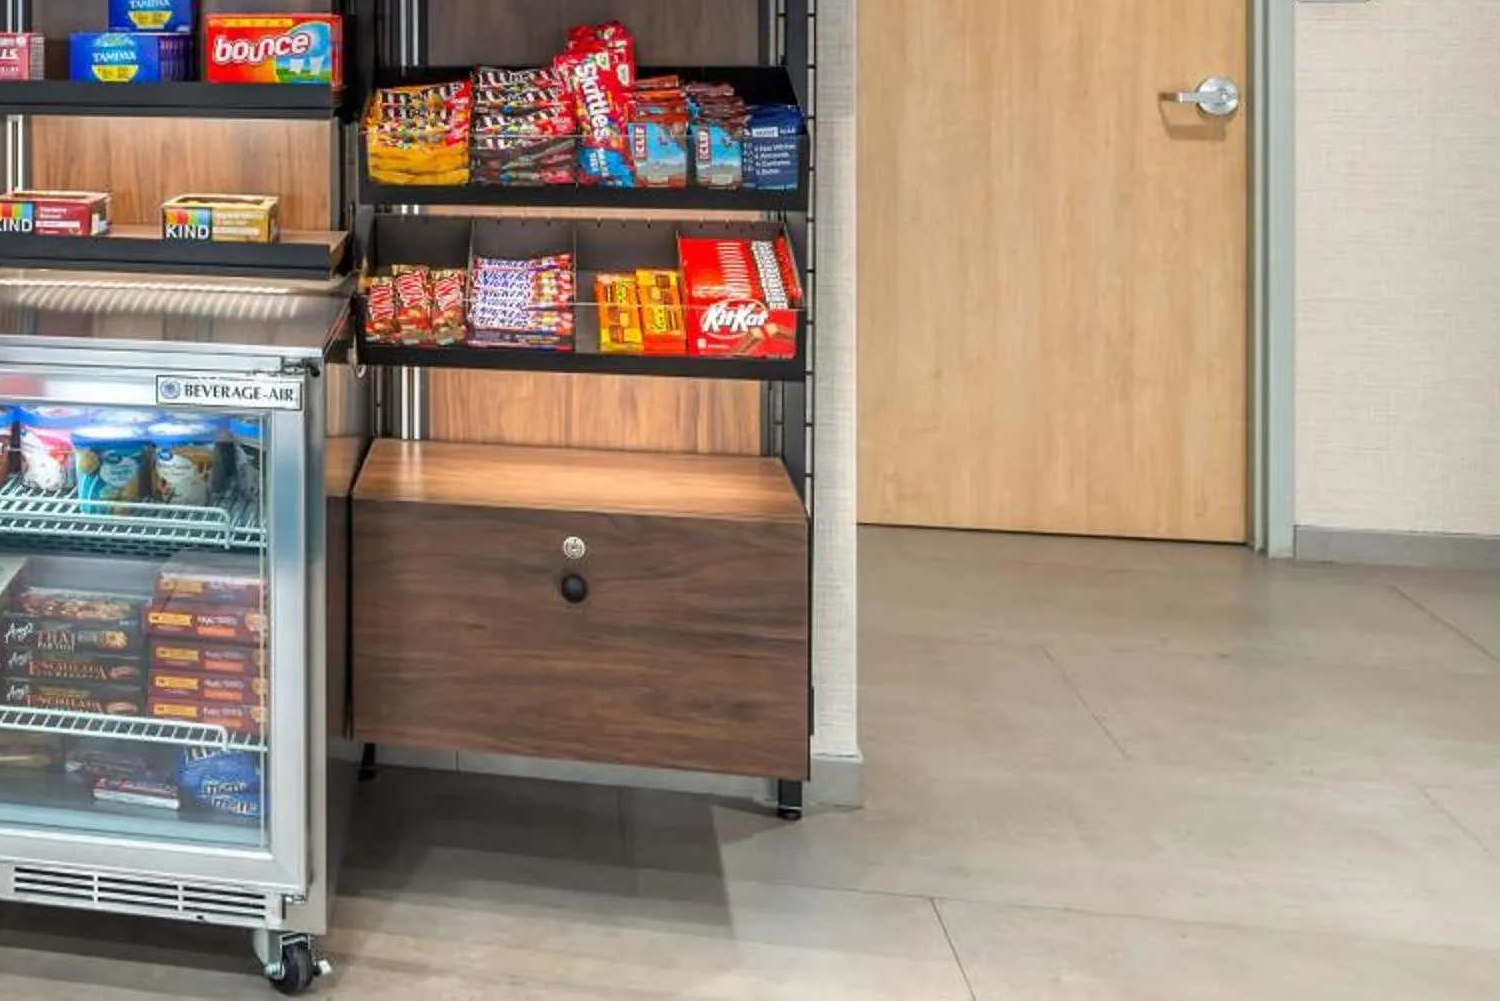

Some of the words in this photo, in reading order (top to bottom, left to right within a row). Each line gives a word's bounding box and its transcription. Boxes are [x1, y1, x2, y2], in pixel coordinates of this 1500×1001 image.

[215, 33, 310, 65] bounce
[575, 62, 611, 143] Skittles
[165, 224, 209, 240] KIND
[184, 384, 293, 401] BEVERAGE-AIR
